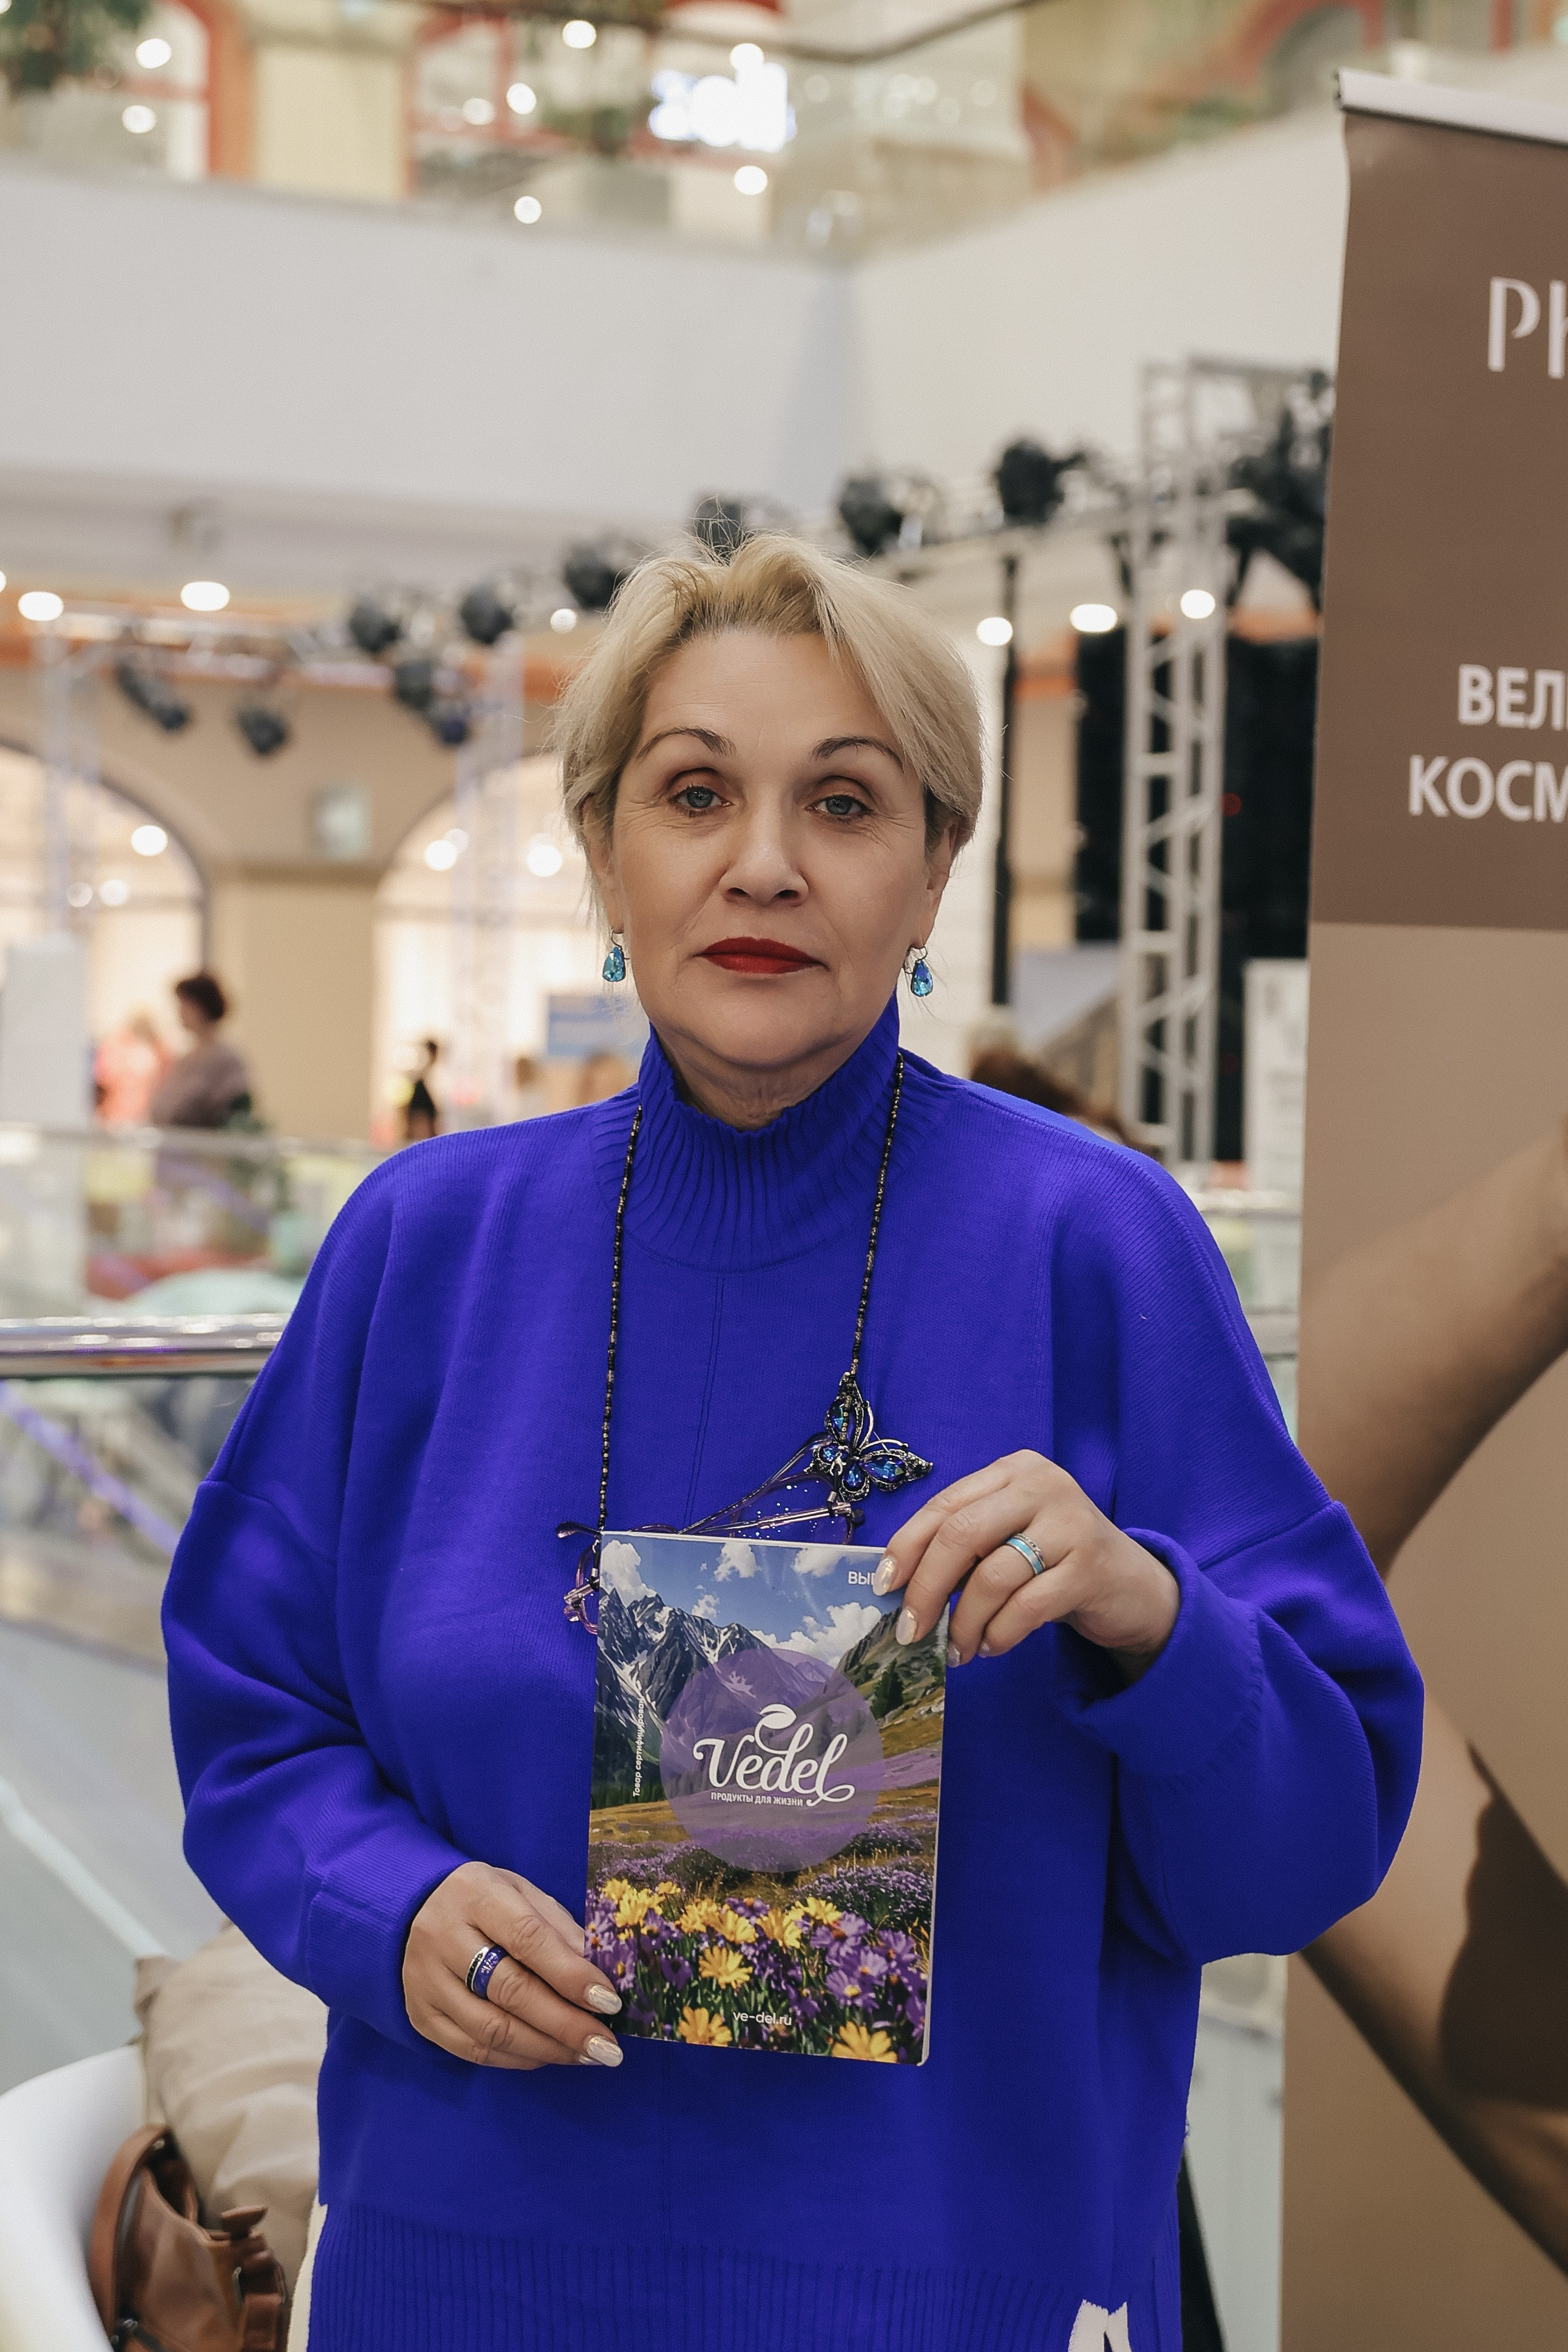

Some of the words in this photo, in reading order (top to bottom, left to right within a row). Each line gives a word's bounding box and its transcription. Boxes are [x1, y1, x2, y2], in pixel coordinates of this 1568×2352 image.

[1458, 663, 1568, 731] ВЕЛ
[635, 1698, 646, 1770] сертифицирован
[693, 1704, 856, 1806] Vedel
[633, 1771, 642, 1797] Товар
[711, 1792, 753, 1803] ПРОДУКТЫ
[754, 1795, 772, 1804] ДЛЯ
[773, 1796, 804, 1806] ЖИЗНИ
[732, 2011, 792, 2025] ve-del.ru
